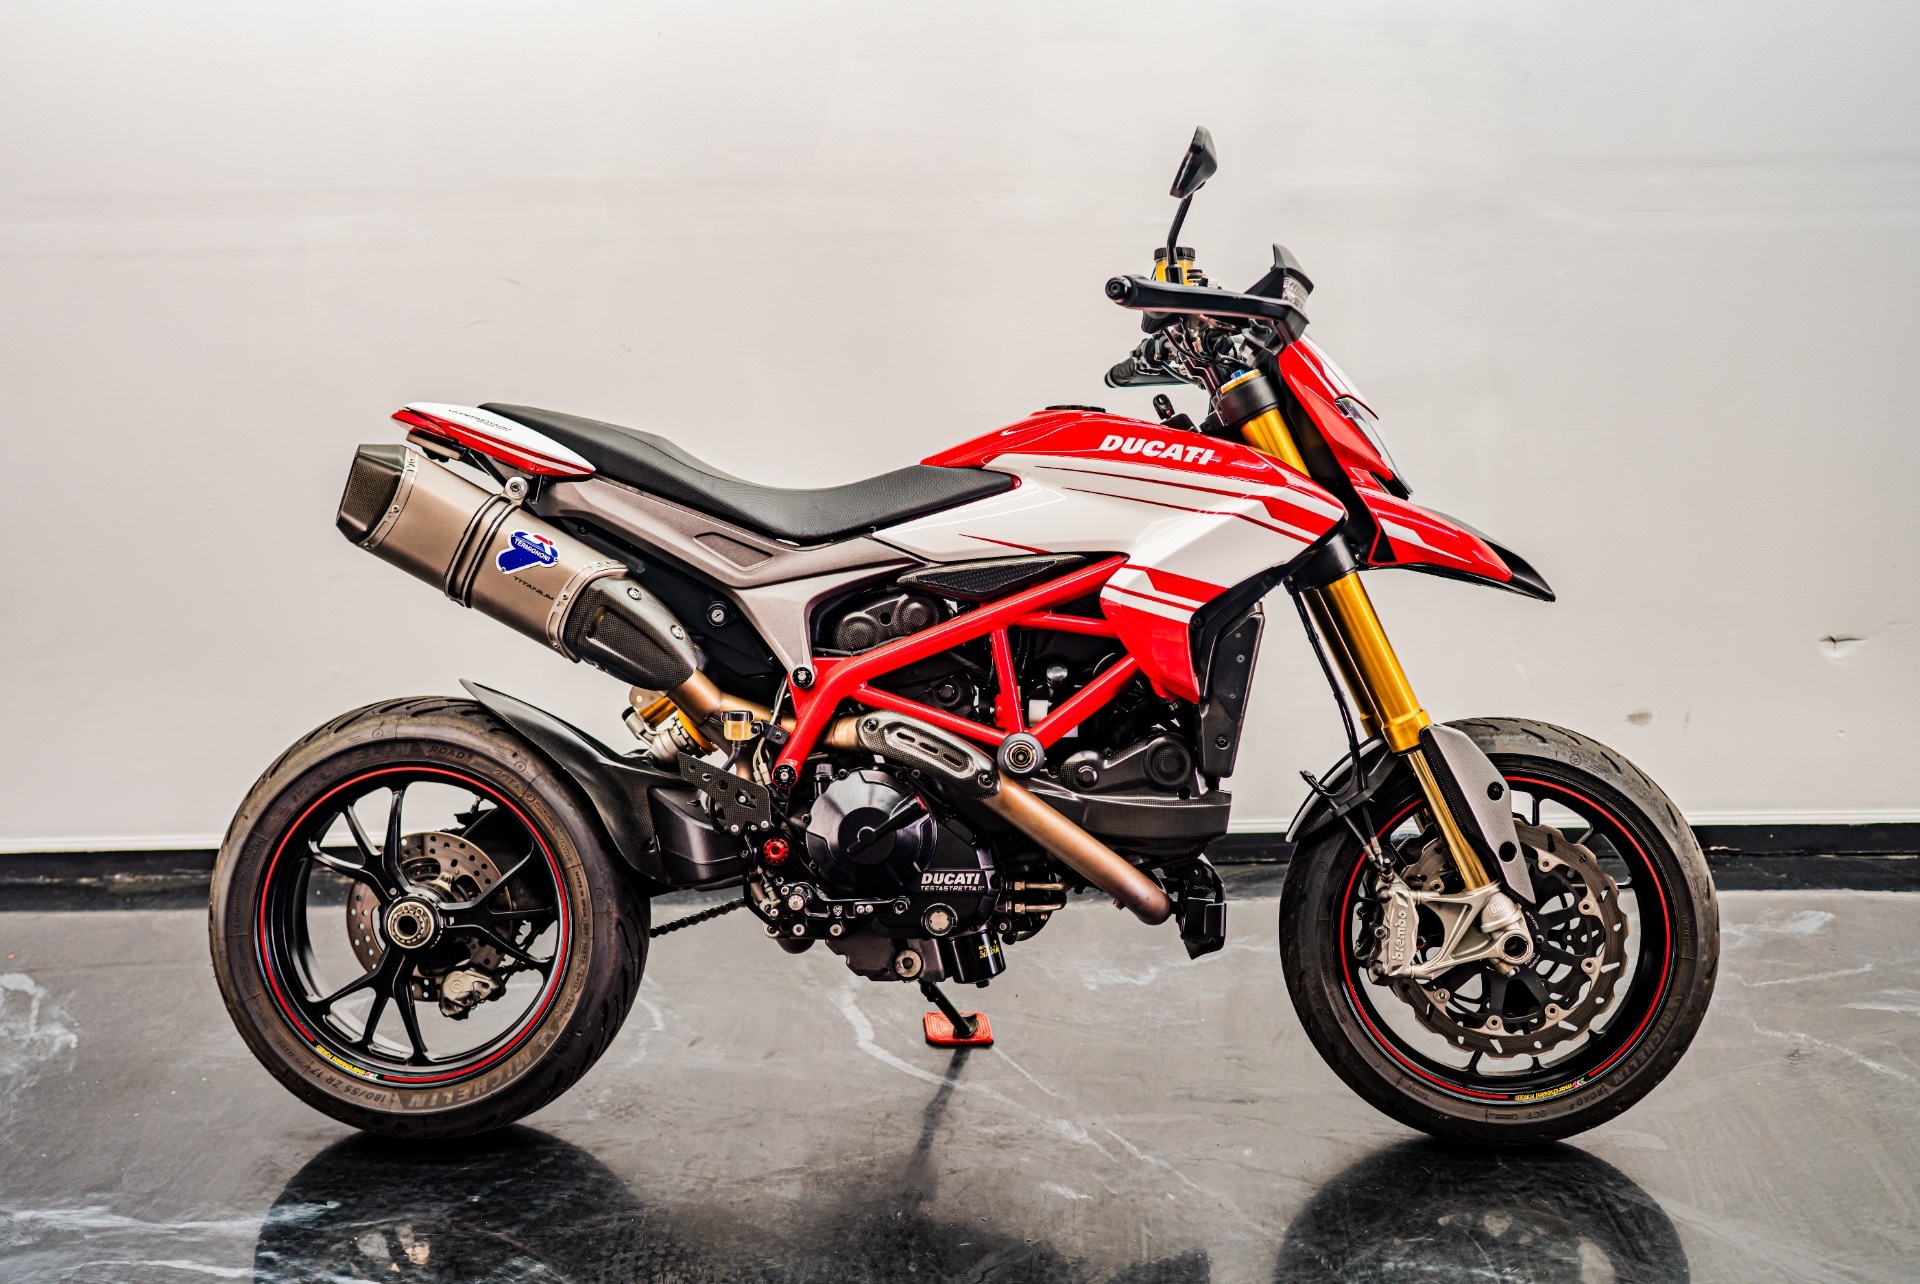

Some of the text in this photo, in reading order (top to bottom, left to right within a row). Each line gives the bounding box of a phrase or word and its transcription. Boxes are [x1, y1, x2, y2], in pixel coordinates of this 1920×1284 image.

[1098, 434, 1216, 466] DUCATI
[514, 538, 551, 562] TERMIGNONI
[513, 575, 555, 601] TITANIUM
[921, 872, 981, 885] DUCATI
[1391, 910, 1408, 961] brembo
[1613, 1011, 1674, 1085] MICHELIN
[310, 1067, 387, 1103] 180/55 ZR 17
[407, 1049, 533, 1109] MICHELIN
[1535, 1083, 1573, 1100] marchesini
